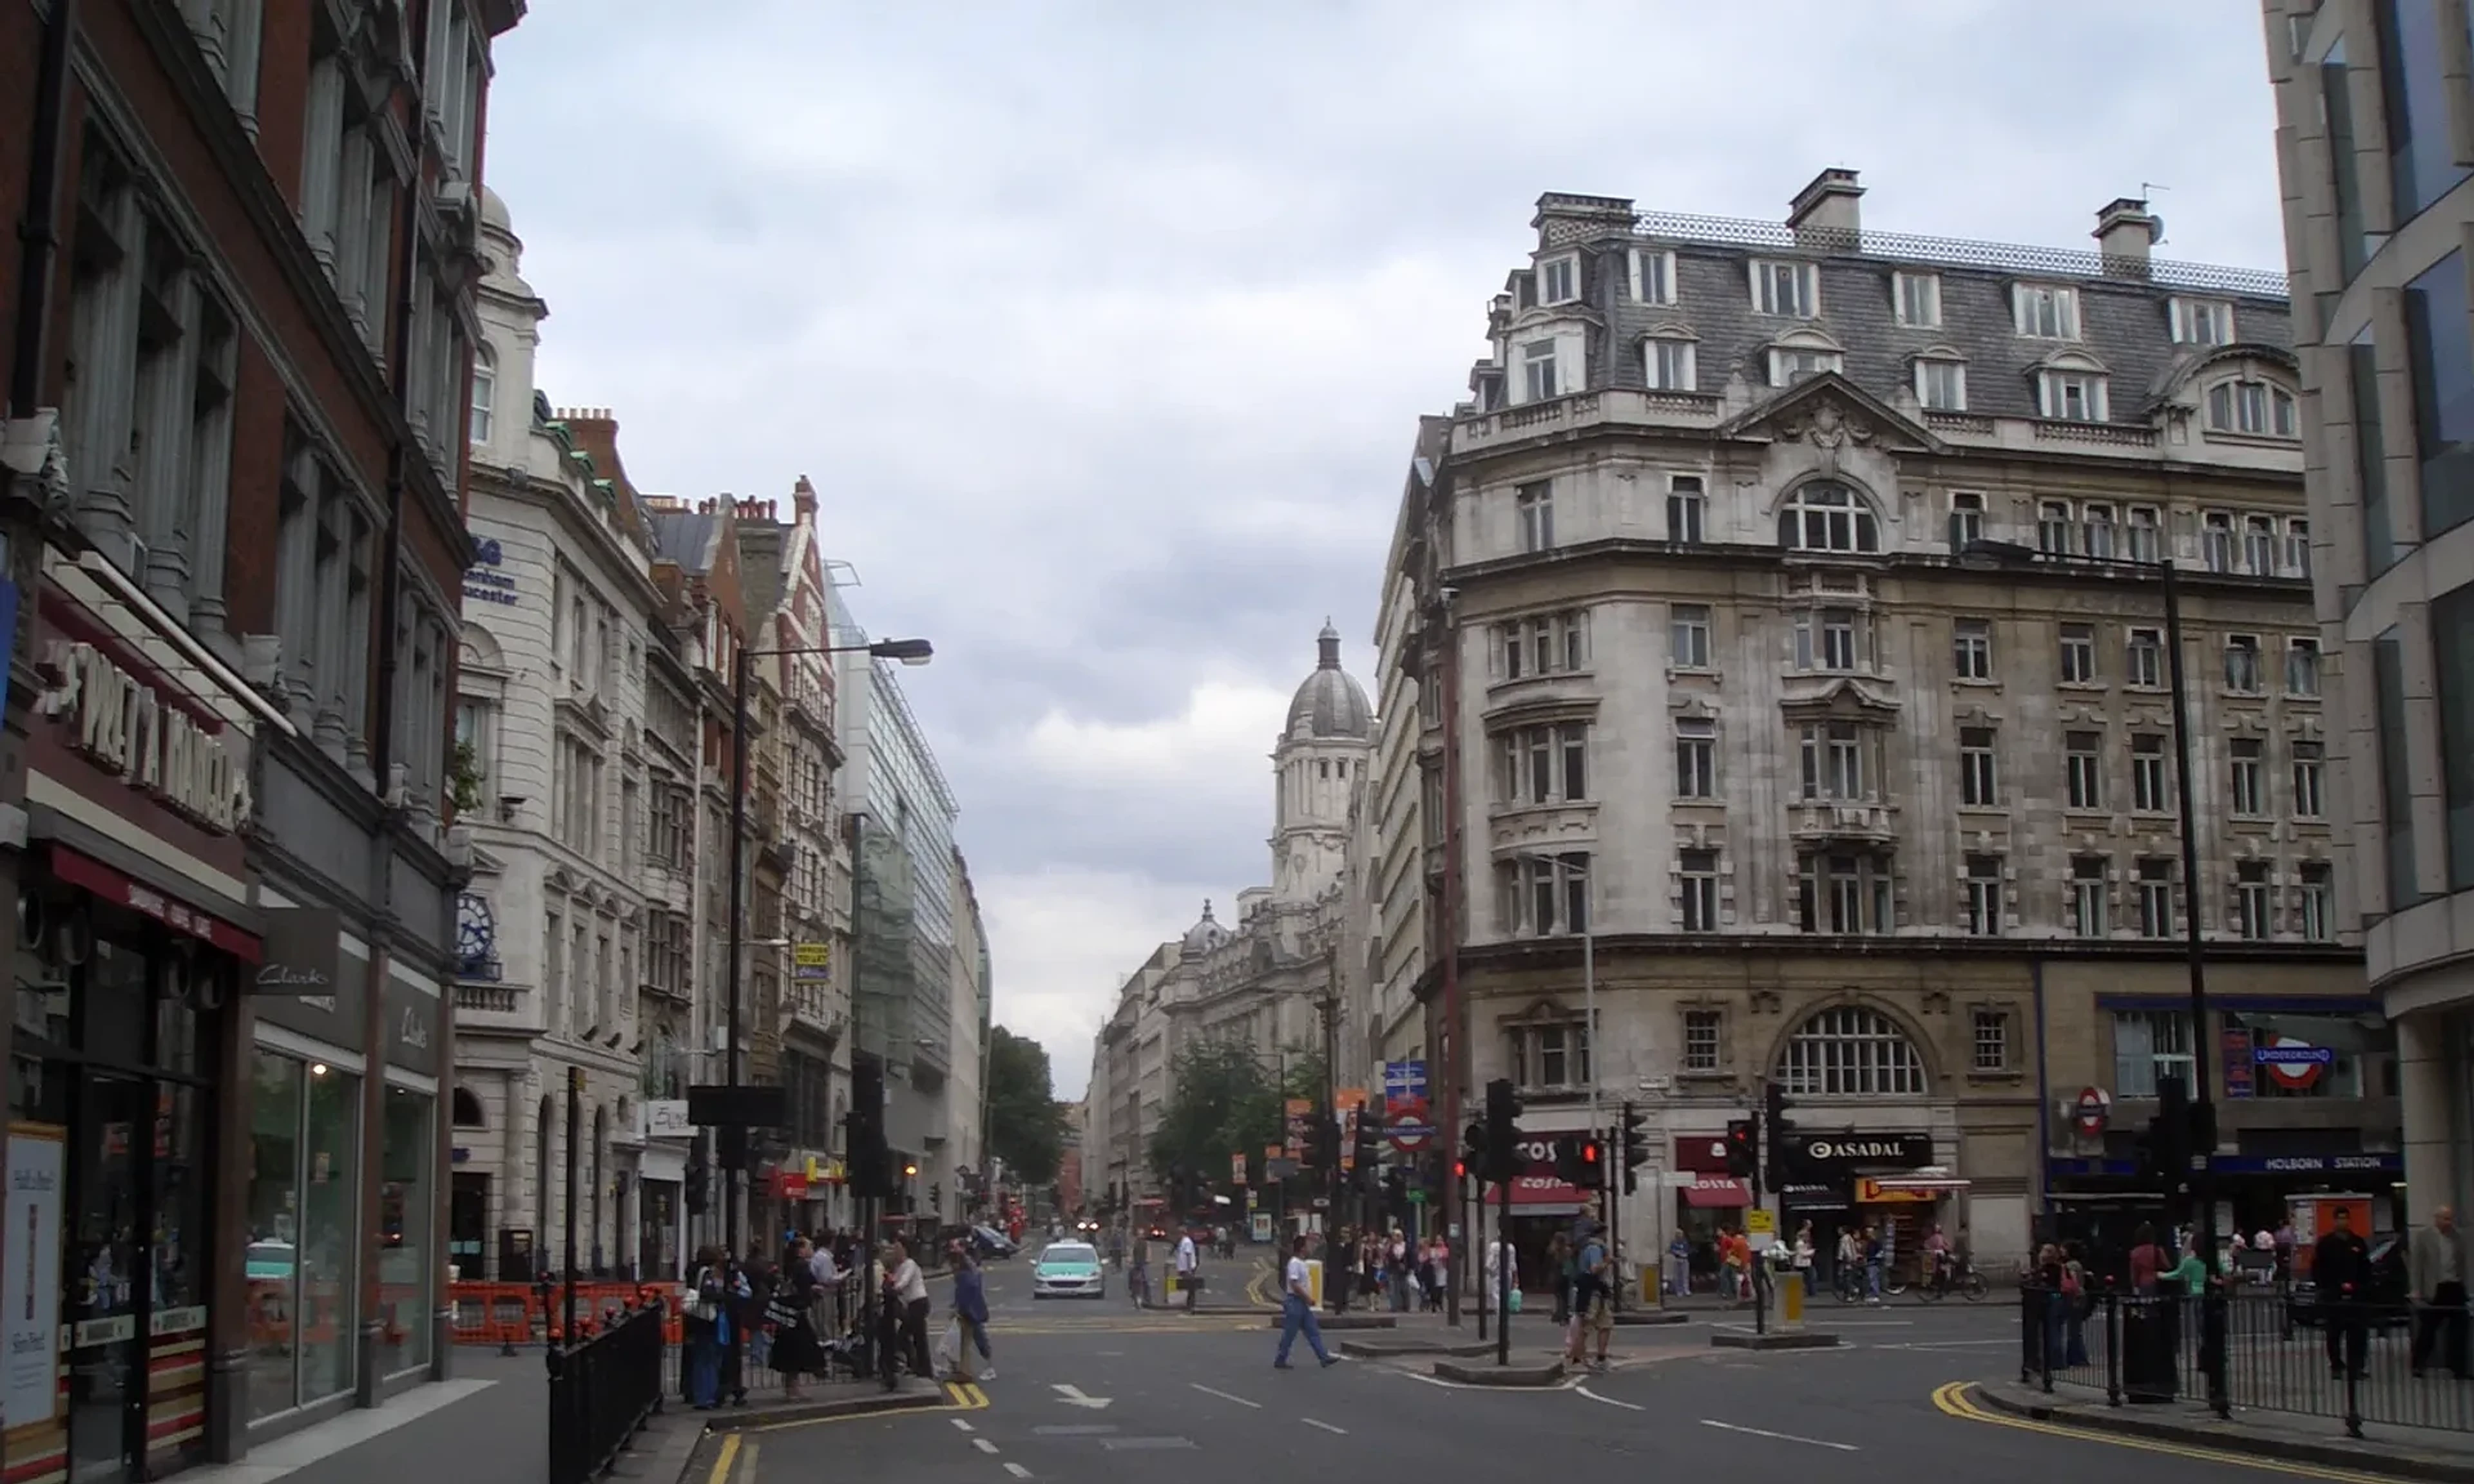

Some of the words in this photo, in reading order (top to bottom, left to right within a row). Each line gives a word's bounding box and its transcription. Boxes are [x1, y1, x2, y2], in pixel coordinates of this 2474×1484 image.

[256, 964, 329, 985] Clarks
[2258, 1049, 2330, 1061] UNDERGROUND
[1832, 1143, 1904, 1157] ASADAL
[2266, 1158, 2323, 1170] HOLBORN
[2334, 1157, 2381, 1169] STATION
